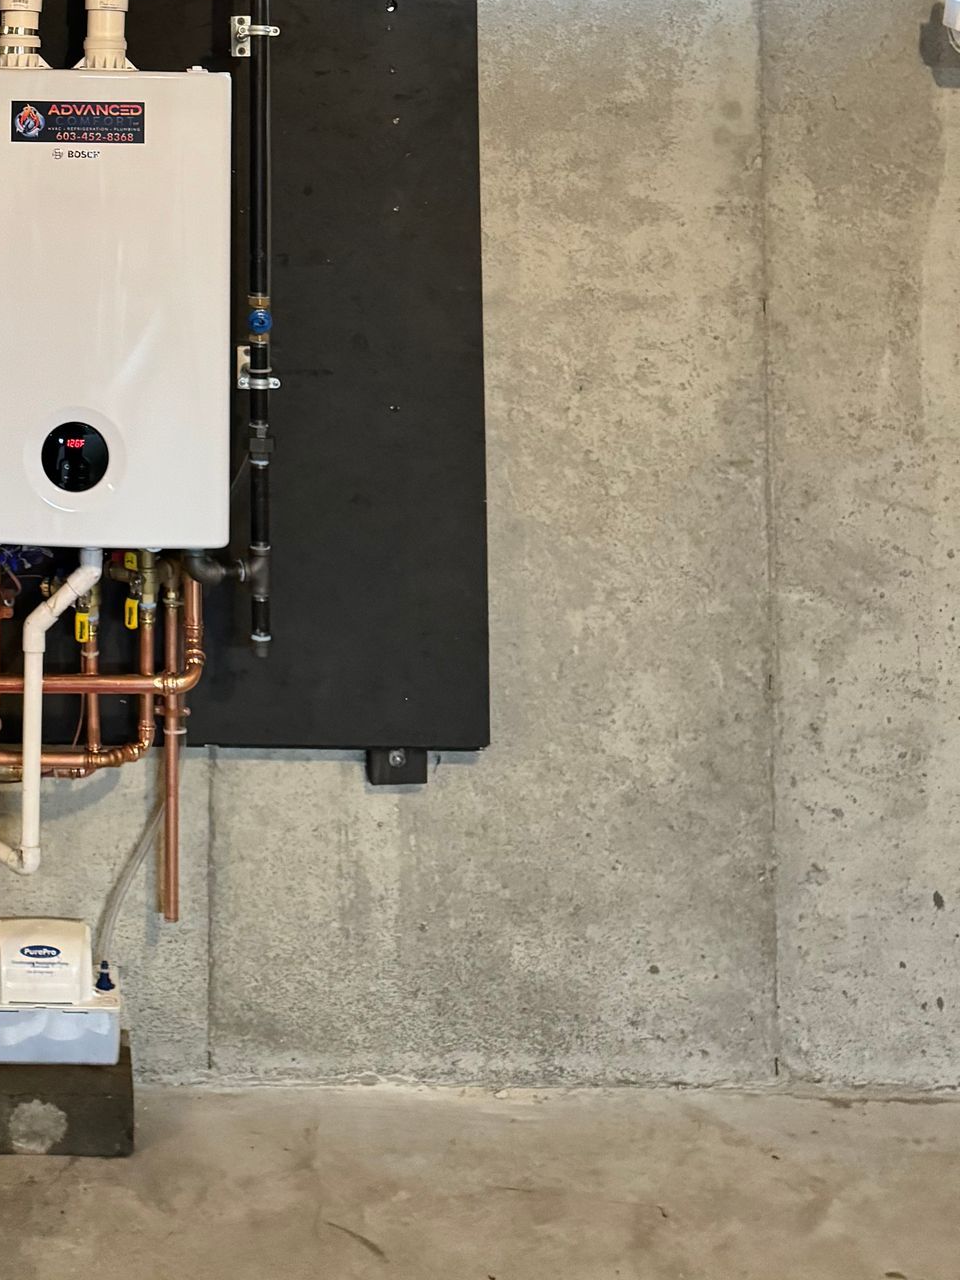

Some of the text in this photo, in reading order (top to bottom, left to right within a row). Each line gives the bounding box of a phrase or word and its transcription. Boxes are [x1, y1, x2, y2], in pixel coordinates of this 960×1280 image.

[48, 104, 143, 116] ADVANCED
[55, 116, 135, 126] COMFORT
[56, 132, 134, 142] 603-452-8368
